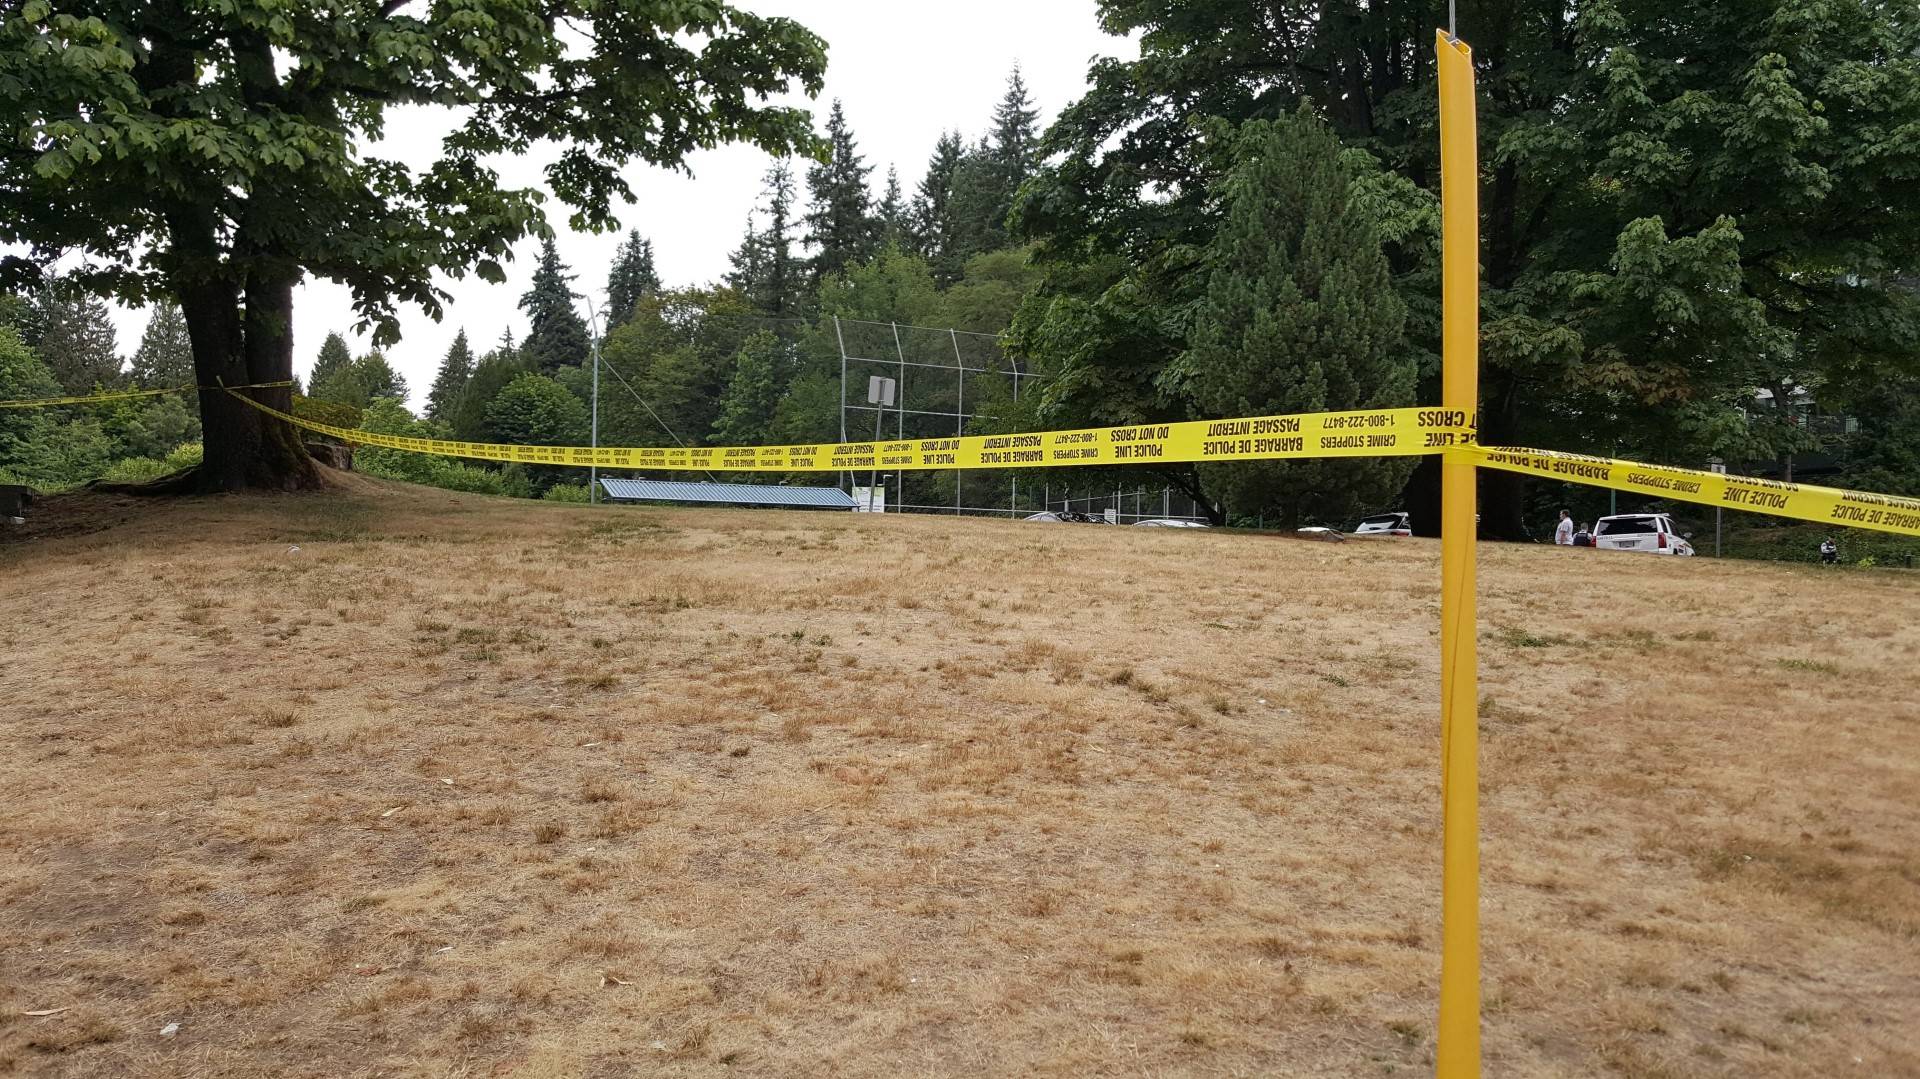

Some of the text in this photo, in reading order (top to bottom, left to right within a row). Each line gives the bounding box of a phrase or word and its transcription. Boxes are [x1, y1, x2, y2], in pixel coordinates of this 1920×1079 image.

[1323, 415, 1395, 428] 1-800-222-8477
[1418, 411, 1465, 427] CROSS
[1111, 426, 1169, 442] DO NOT CROSS
[1207, 418, 1300, 436] PASSAGE INTERDIT
[921, 440, 960, 451] DO NOT CROSS
[984, 435, 1042, 449] PASSAGE INTERDIT
[1204, 437, 1303, 454] BARRAGE DE POLICE
[1320, 434, 1396, 448] CRIME STOPPERS
[1424, 433, 1454, 447] LINE
[981, 450, 1043, 464] BARRAGE DE POLICE
[1054, 448, 1098, 459] CRIME STOPPERS
[1115, 444, 1162, 458] POLICE LINE
[923, 454, 955, 465] POLICE LINE
[1626, 473, 1701, 494] CRIME STOPPERS
[1722, 487, 1789, 509] POLICE LINE
[1831, 504, 1920, 530] ARRAGE DE POLICE
